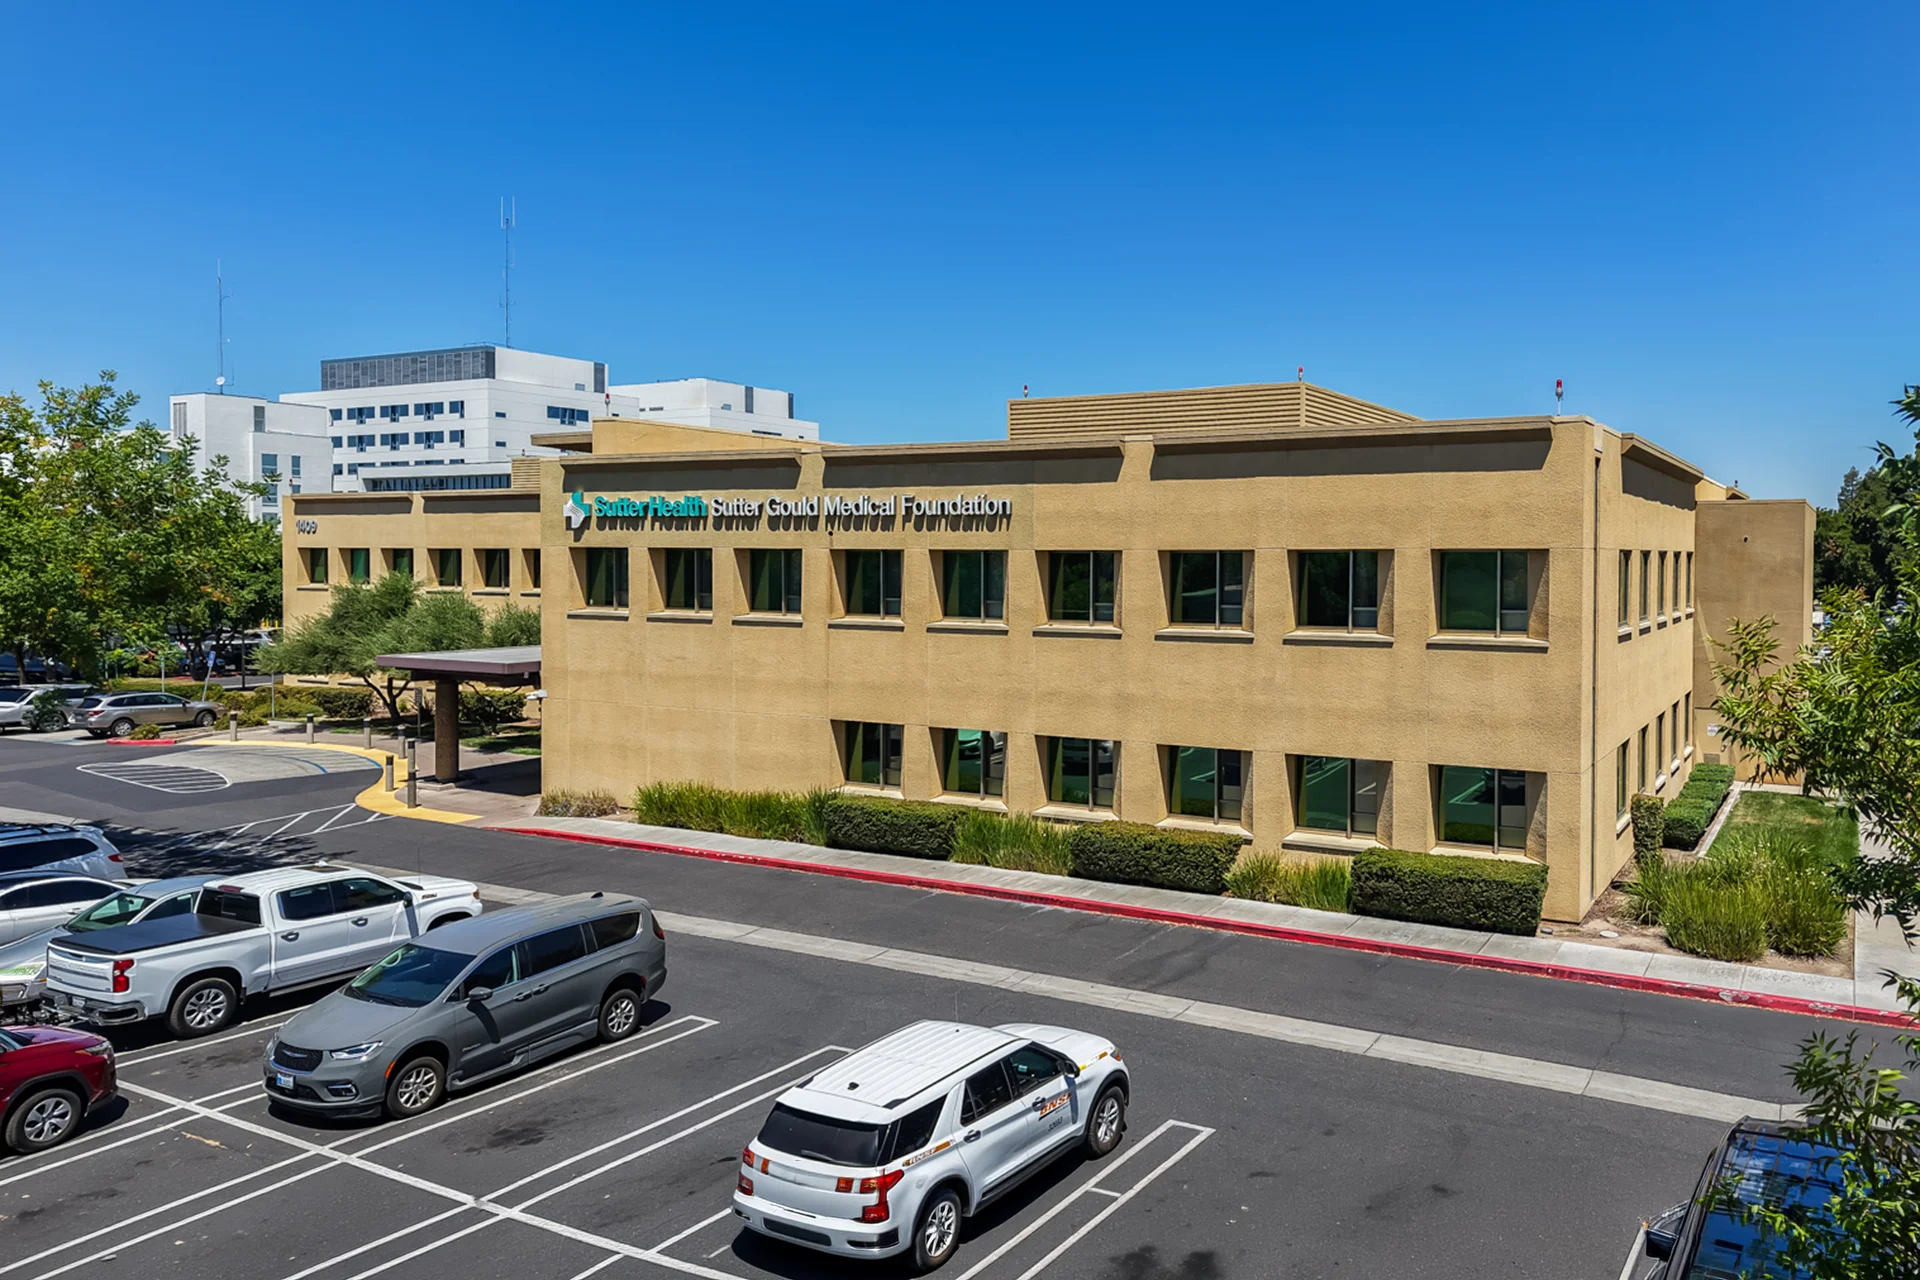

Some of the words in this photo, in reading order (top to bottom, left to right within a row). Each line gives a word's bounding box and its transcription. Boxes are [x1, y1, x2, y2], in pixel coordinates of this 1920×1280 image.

[594, 495, 648, 517] Sutter
[650, 495, 707, 517] Health
[711, 496, 764, 517] Sutter
[765, 495, 819, 517] Gould
[823, 495, 895, 517] Medical
[901, 493, 1012, 516] Foundation
[296, 519, 318, 534] 1409
